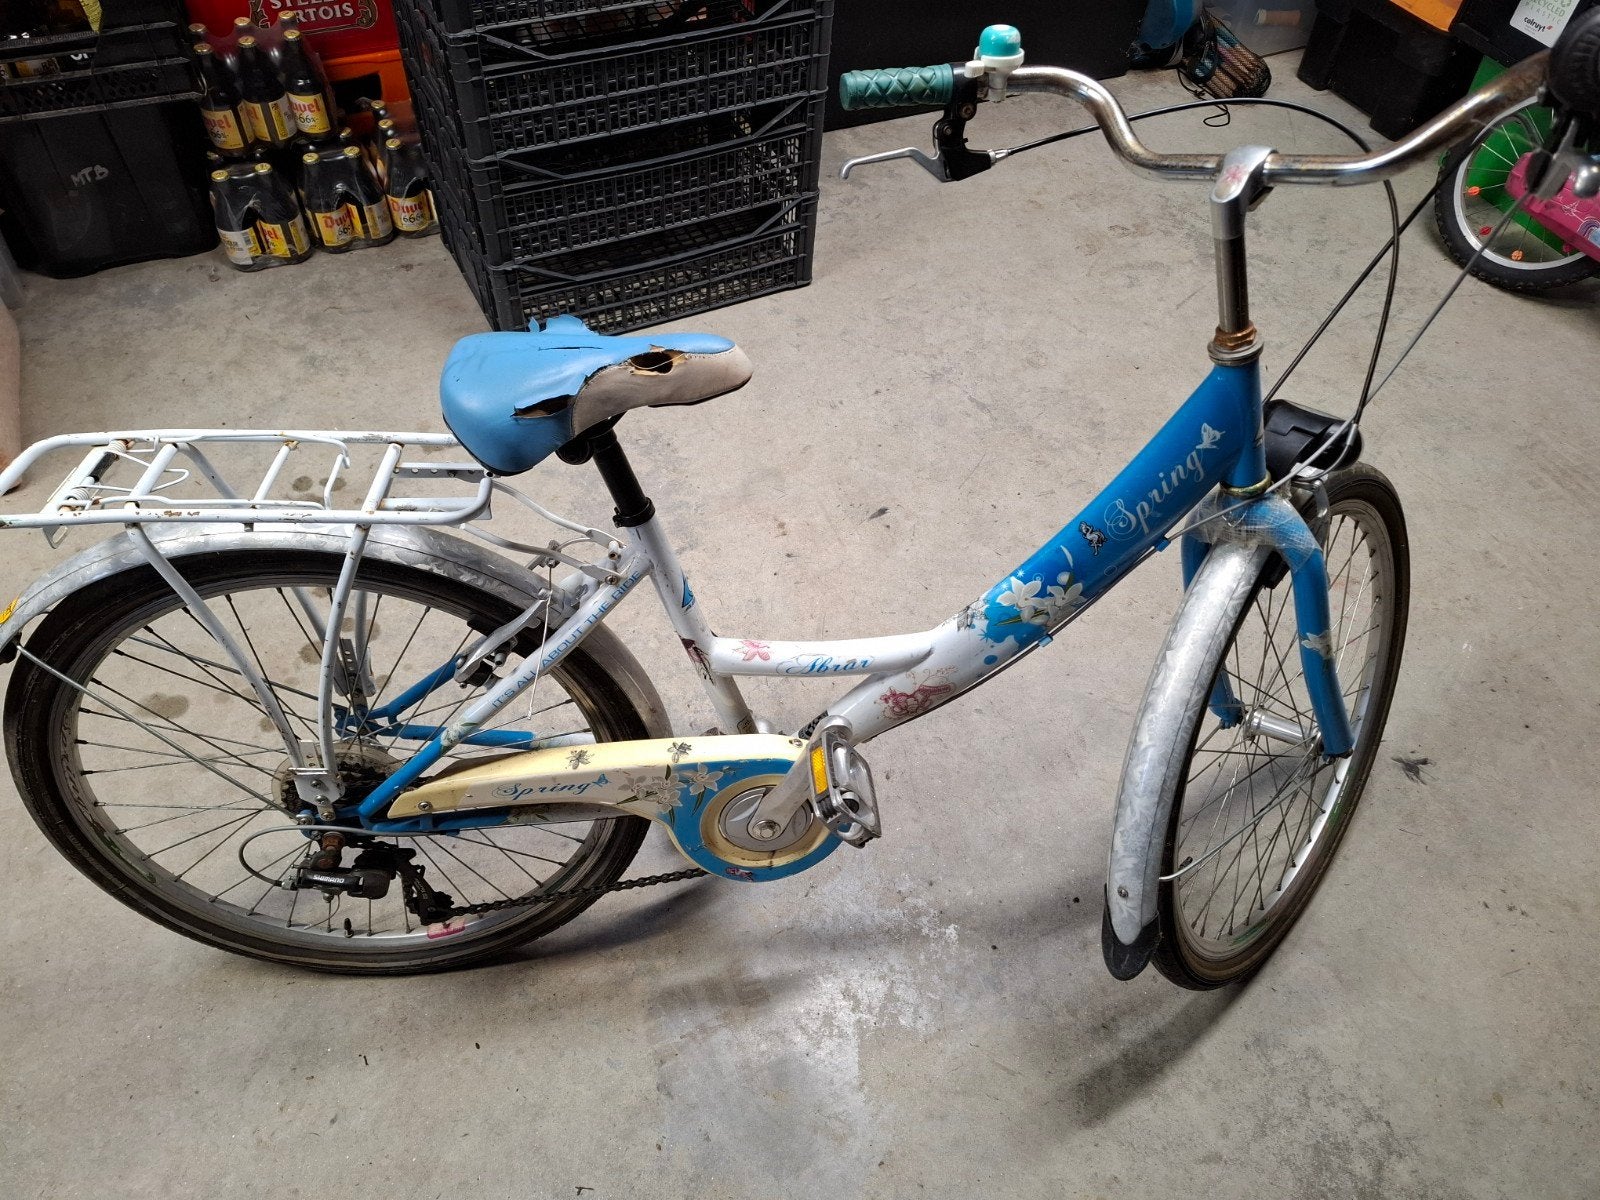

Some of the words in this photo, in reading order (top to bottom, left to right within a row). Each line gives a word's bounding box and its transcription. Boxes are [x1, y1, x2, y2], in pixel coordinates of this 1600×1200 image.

[294, 2, 354, 23] RTOIS
[292, 98, 320, 113] uvel
[391, 198, 423, 214] Duve
[1104, 449, 1205, 541] Spring
[491, 687, 516, 710] IT'S
[541, 628, 585, 668] ABOUT
[584, 601, 612, 626] THE
[611, 571, 641, 600] RIDE
[491, 783, 592, 801] Spring
[312, 874, 345, 884] SHIMANO
